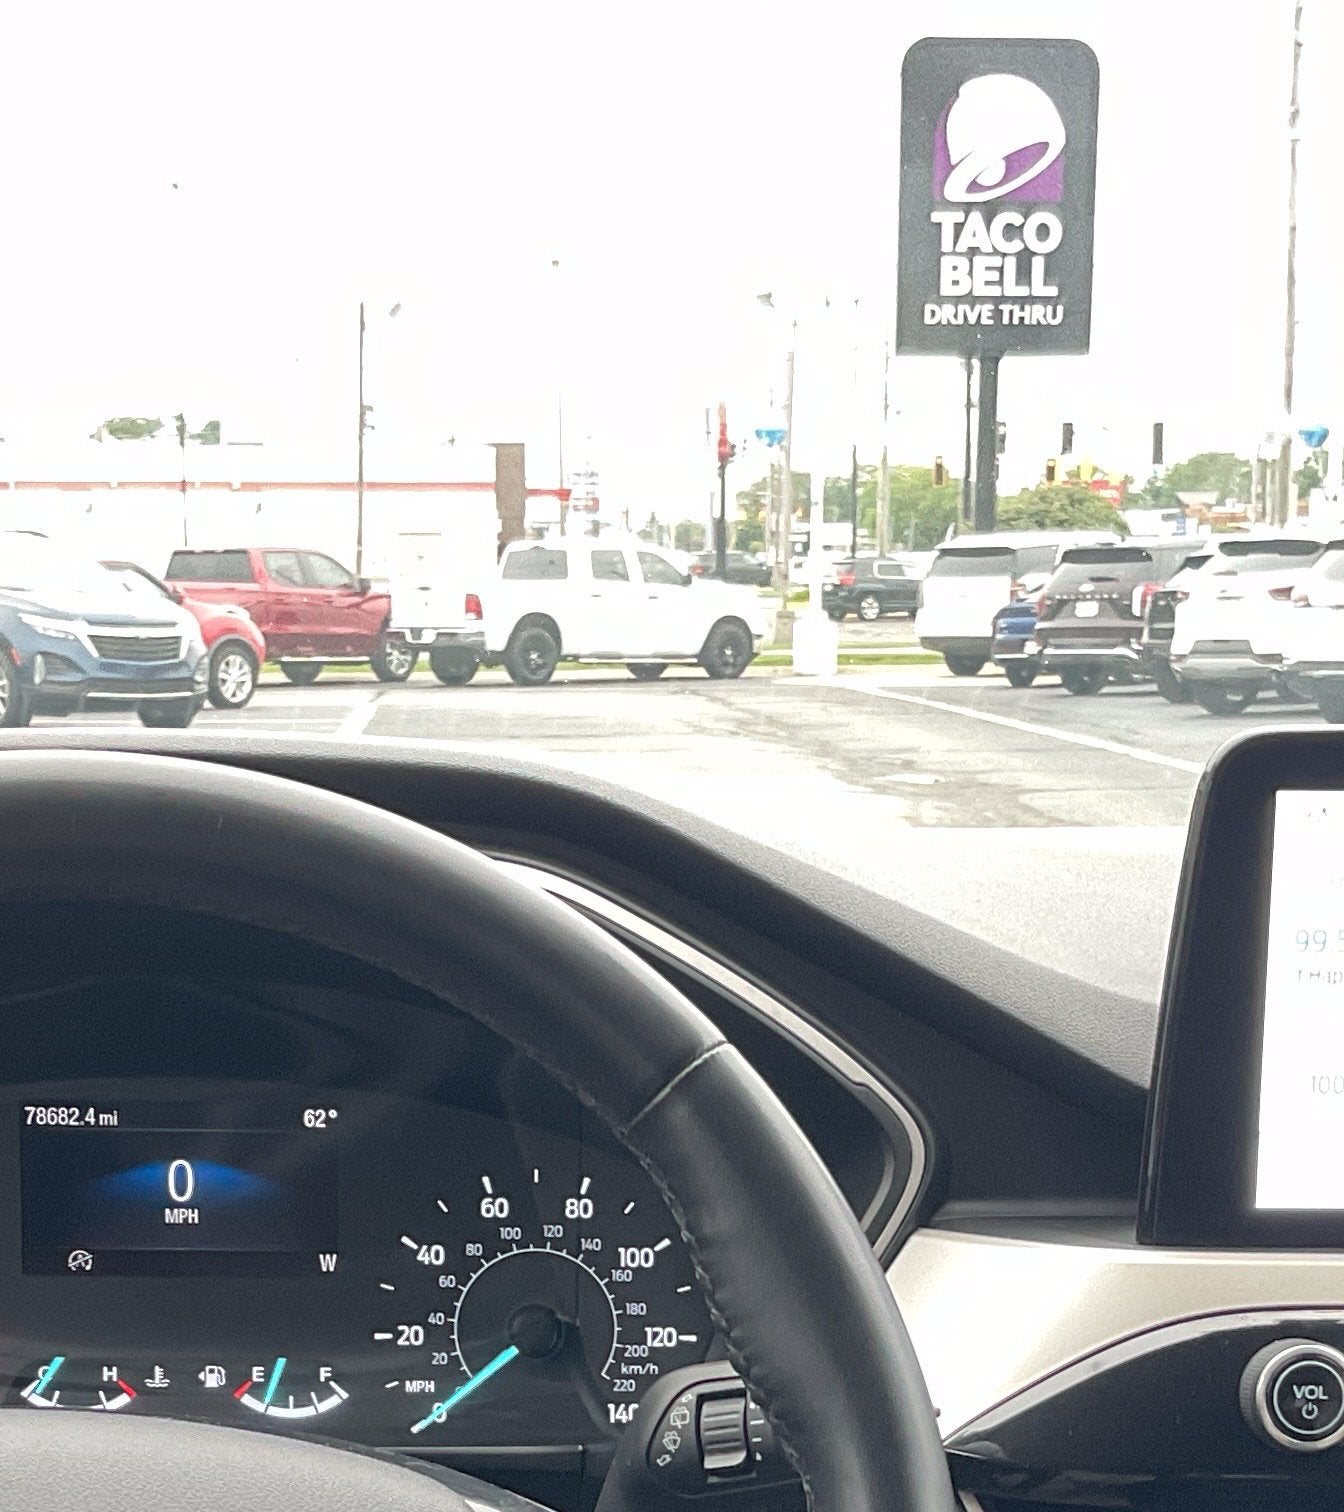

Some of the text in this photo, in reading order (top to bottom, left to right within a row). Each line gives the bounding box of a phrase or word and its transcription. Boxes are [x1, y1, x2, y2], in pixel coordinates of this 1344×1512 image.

[930, 211, 1063, 253] TACO
[940, 255, 1059, 297] BELL
[923, 304, 1064, 326] DRIVE THRU
[24, 1106, 119, 1127] 78682.4 mi
[303, 1108, 339, 1128] 62°
[167, 1159, 195, 1203] 0
[480, 1197, 510, 1219] 60
[564, 1198, 594, 1220] 80
[164, 1208, 199, 1225] MPH
[499, 1227, 522, 1241] 100
[542, 1225, 564, 1239] 120
[465, 1243, 483, 1257] 80
[580, 1238, 602, 1252] 140
[318, 1253, 338, 1272] W
[416, 1244, 446, 1266] 40
[617, 1247, 655, 1268] 100
[438, 1275, 456, 1289] 60
[611, 1269, 633, 1283] 160
[625, 1302, 647, 1316] 180
[427, 1313, 445, 1326] 40
[396, 1325, 424, 1347] 20
[644, 1327, 678, 1348] 120
[431, 1353, 448, 1366] 20
[623, 1345, 649, 1358] 200
[102, 1366, 118, 1382] H
[251, 1366, 265, 1382] E
[319, 1366, 333, 1382] F
[620, 1362, 659, 1376] km/h
[405, 1380, 435, 1393] MPH
[613, 1379, 636, 1393] 220
[1291, 1384, 1329, 1400] VOL
